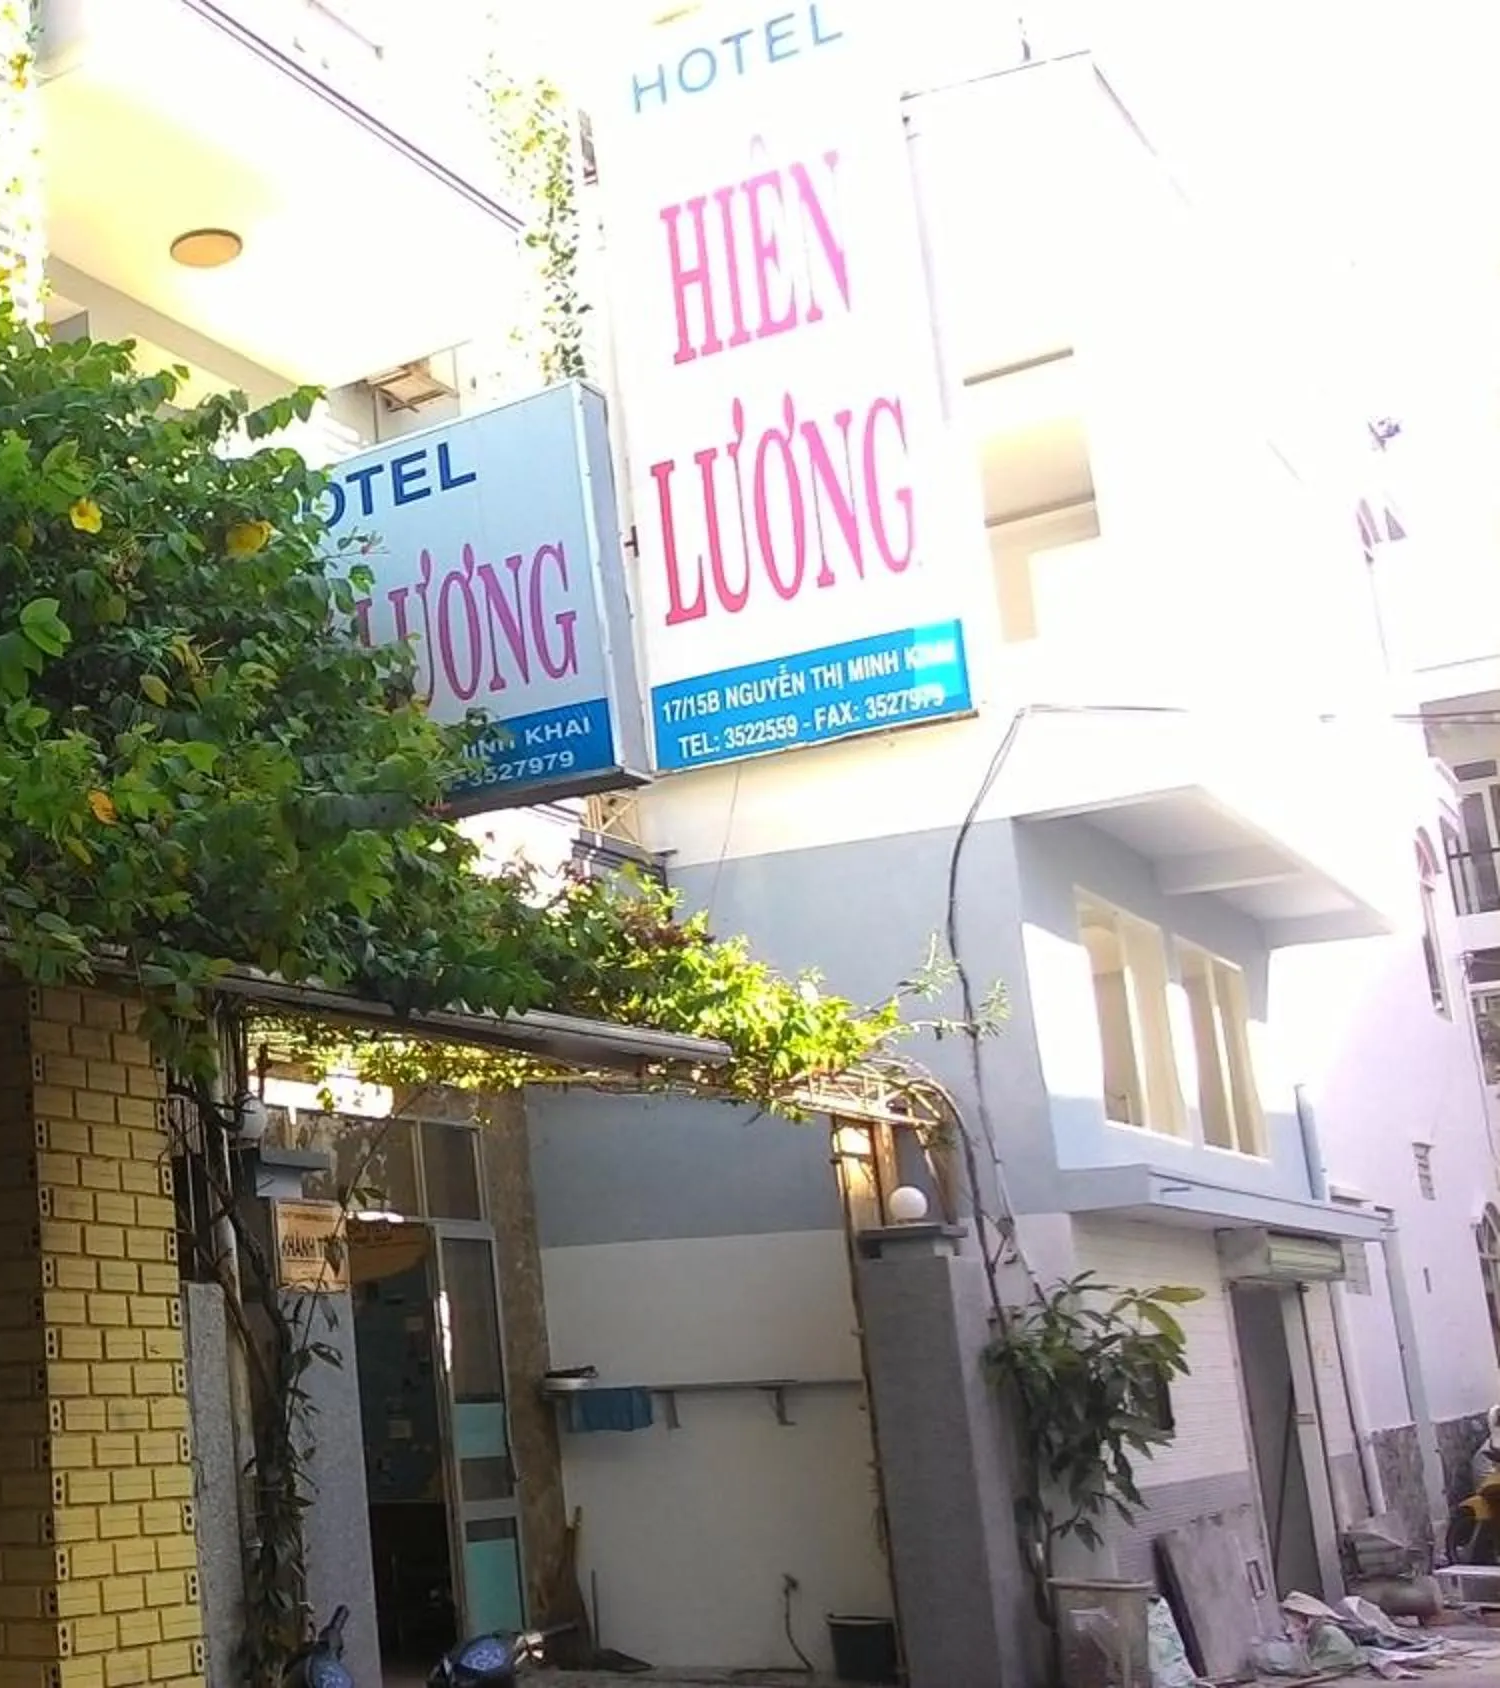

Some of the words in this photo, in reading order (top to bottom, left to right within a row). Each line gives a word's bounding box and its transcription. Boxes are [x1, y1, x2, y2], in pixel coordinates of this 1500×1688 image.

[631, 4, 843, 114] HOTEL
[302, 442, 477, 529] OTEL
[650, 391, 914, 626] LƯƠNG
[662, 690, 721, 724] 17/15B
[811, 667, 844, 690] THỊ
[848, 653, 900, 682] MINH
[524, 716, 592, 746] KHAI
[677, 735, 721, 760] TEL:
[723, 715, 799, 750] 3522559
[814, 700, 860, 731] FAX:
[470, 750, 575, 787] 3527979
